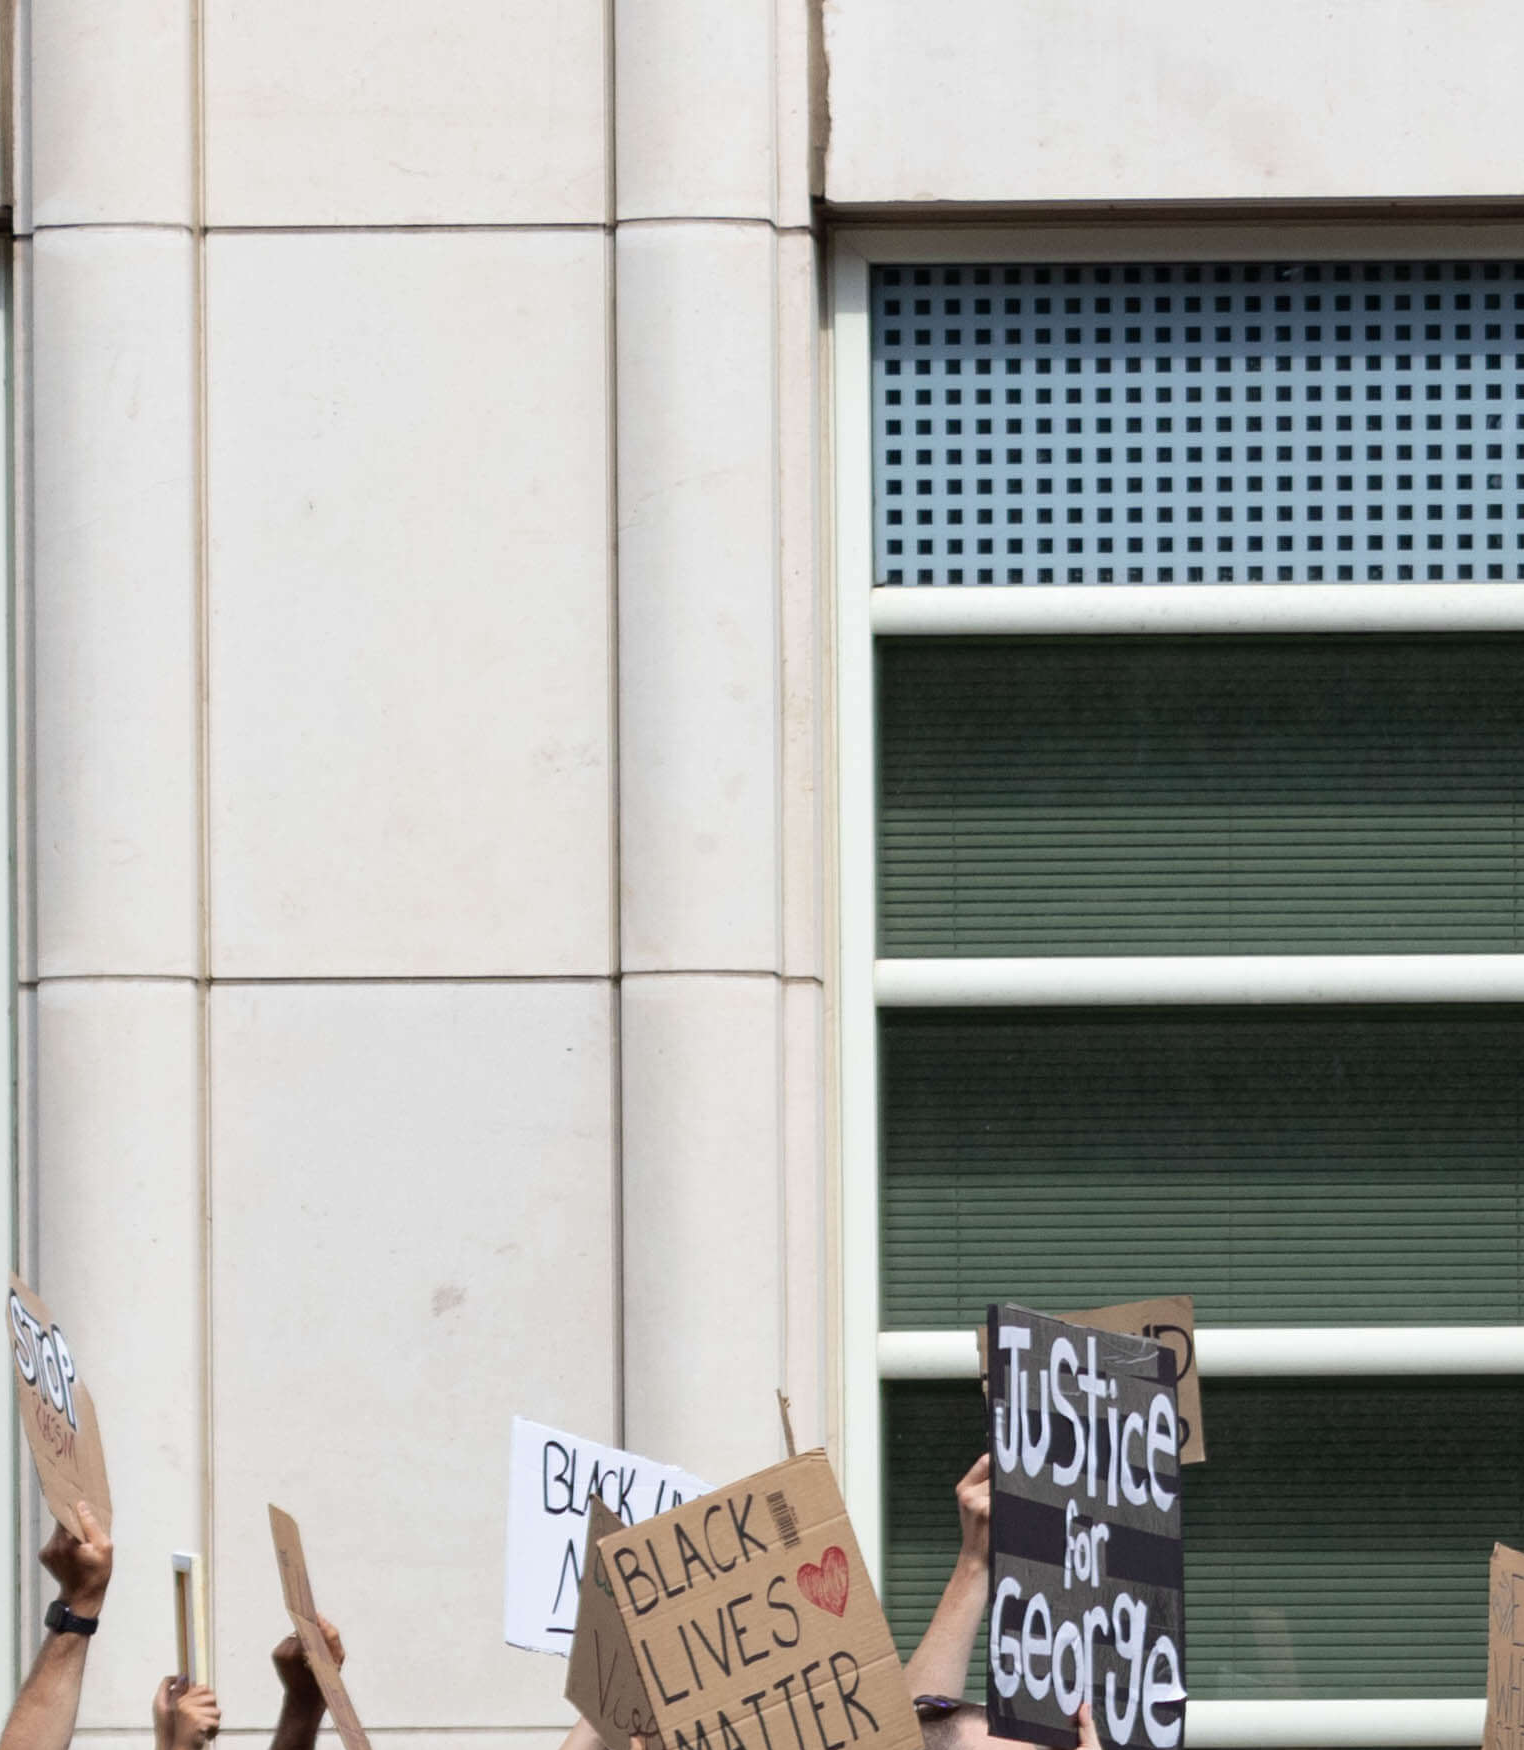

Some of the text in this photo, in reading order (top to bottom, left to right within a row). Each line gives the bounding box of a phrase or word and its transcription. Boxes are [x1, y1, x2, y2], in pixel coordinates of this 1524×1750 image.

[8, 1287, 77, 1432] STOP
[543, 1439, 637, 1527] BLACK
[1063, 1498, 1111, 1590] for
[613, 1494, 769, 1617] BLACK
[640, 1575, 801, 1706] LIVES
[990, 1575, 1187, 1749] George
